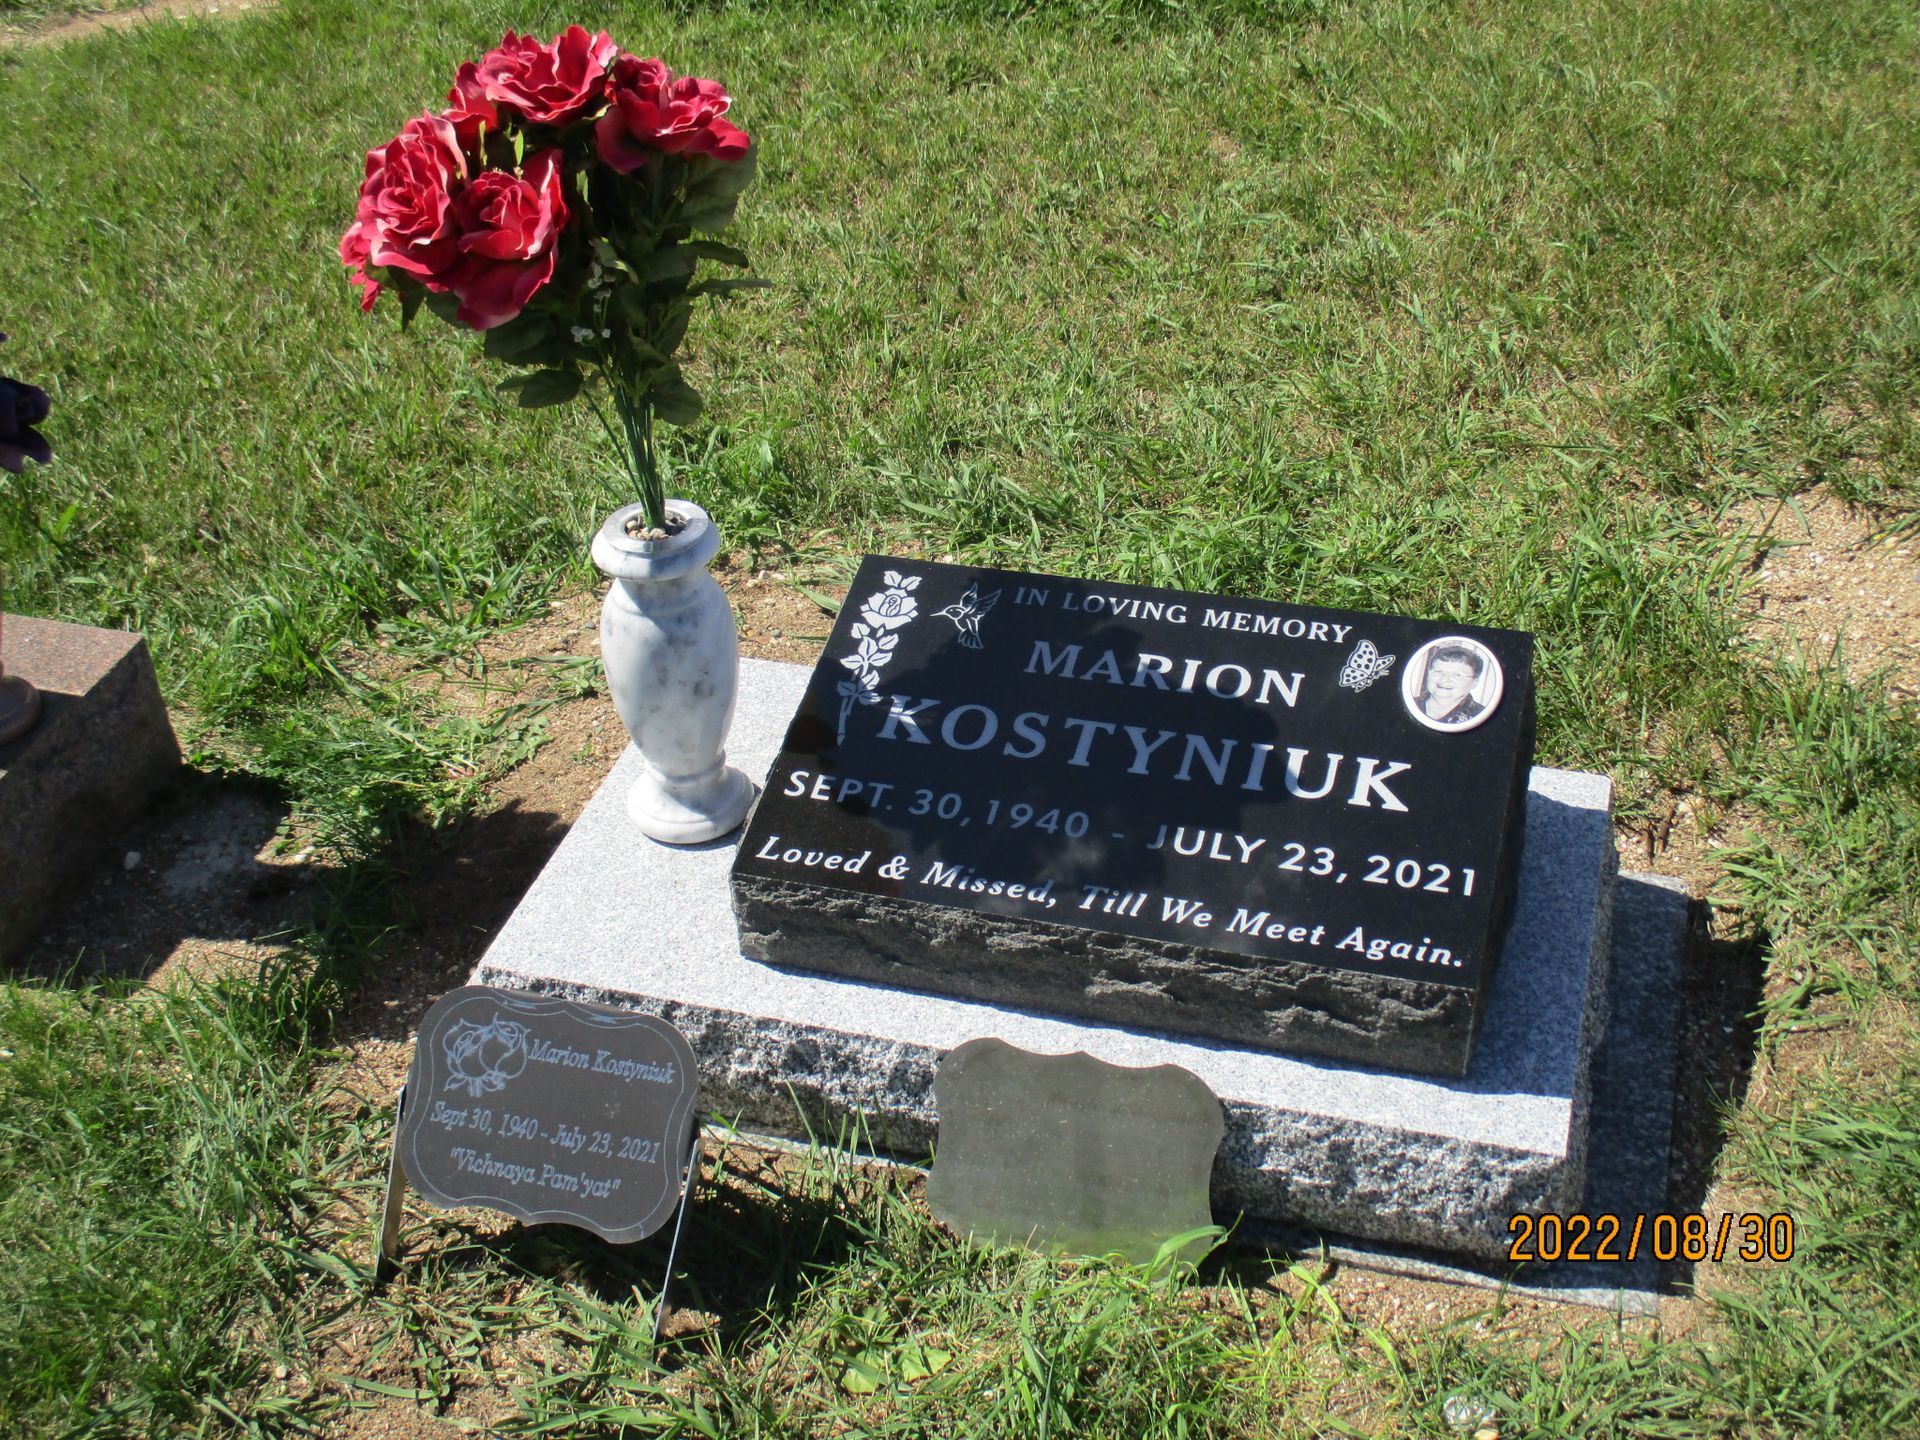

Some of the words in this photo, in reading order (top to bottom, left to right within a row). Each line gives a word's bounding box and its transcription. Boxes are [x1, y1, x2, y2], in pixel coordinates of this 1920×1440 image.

[1013, 587, 1049, 605] IN
[1062, 593, 1187, 624] LOVING
[1202, 608, 1353, 644] MEMORY
[1023, 640, 1306, 708] MARION
[877, 693, 1412, 812] KOSTYNIUK
[783, 769, 895, 811] SEPT.
[908, 788, 971, 828] 30,
[985, 799, 1090, 839] 1940
[1146, 824, 1266, 864] JULY
[1278, 842, 1349, 885] 23,
[1362, 854, 1479, 897] 2021
[754, 835, 872, 875] Loved
[878, 855, 911, 881] &
[919, 860, 1058, 908] Missed,
[1078, 884, 1148, 919] Till
[1160, 896, 1213, 929] We
[1225, 907, 1326, 947] Meet
[1335, 926, 1464, 968] Again.
[527, 1038, 590, 1069] Marion
[591, 1048, 676, 1085] Kostyniuk
[430, 1100, 468, 1131] Sept
[470, 1109, 493, 1136] 30,
[498, 1112, 539, 1141] 1940
[549, 1123, 587, 1155] July
[588, 1130, 614, 1156] 23,
[616, 1136, 662, 1164] 2021
[449, 1147, 536, 1186] "Vichnaya
[537, 1164, 622, 1199] Pam'yat"
